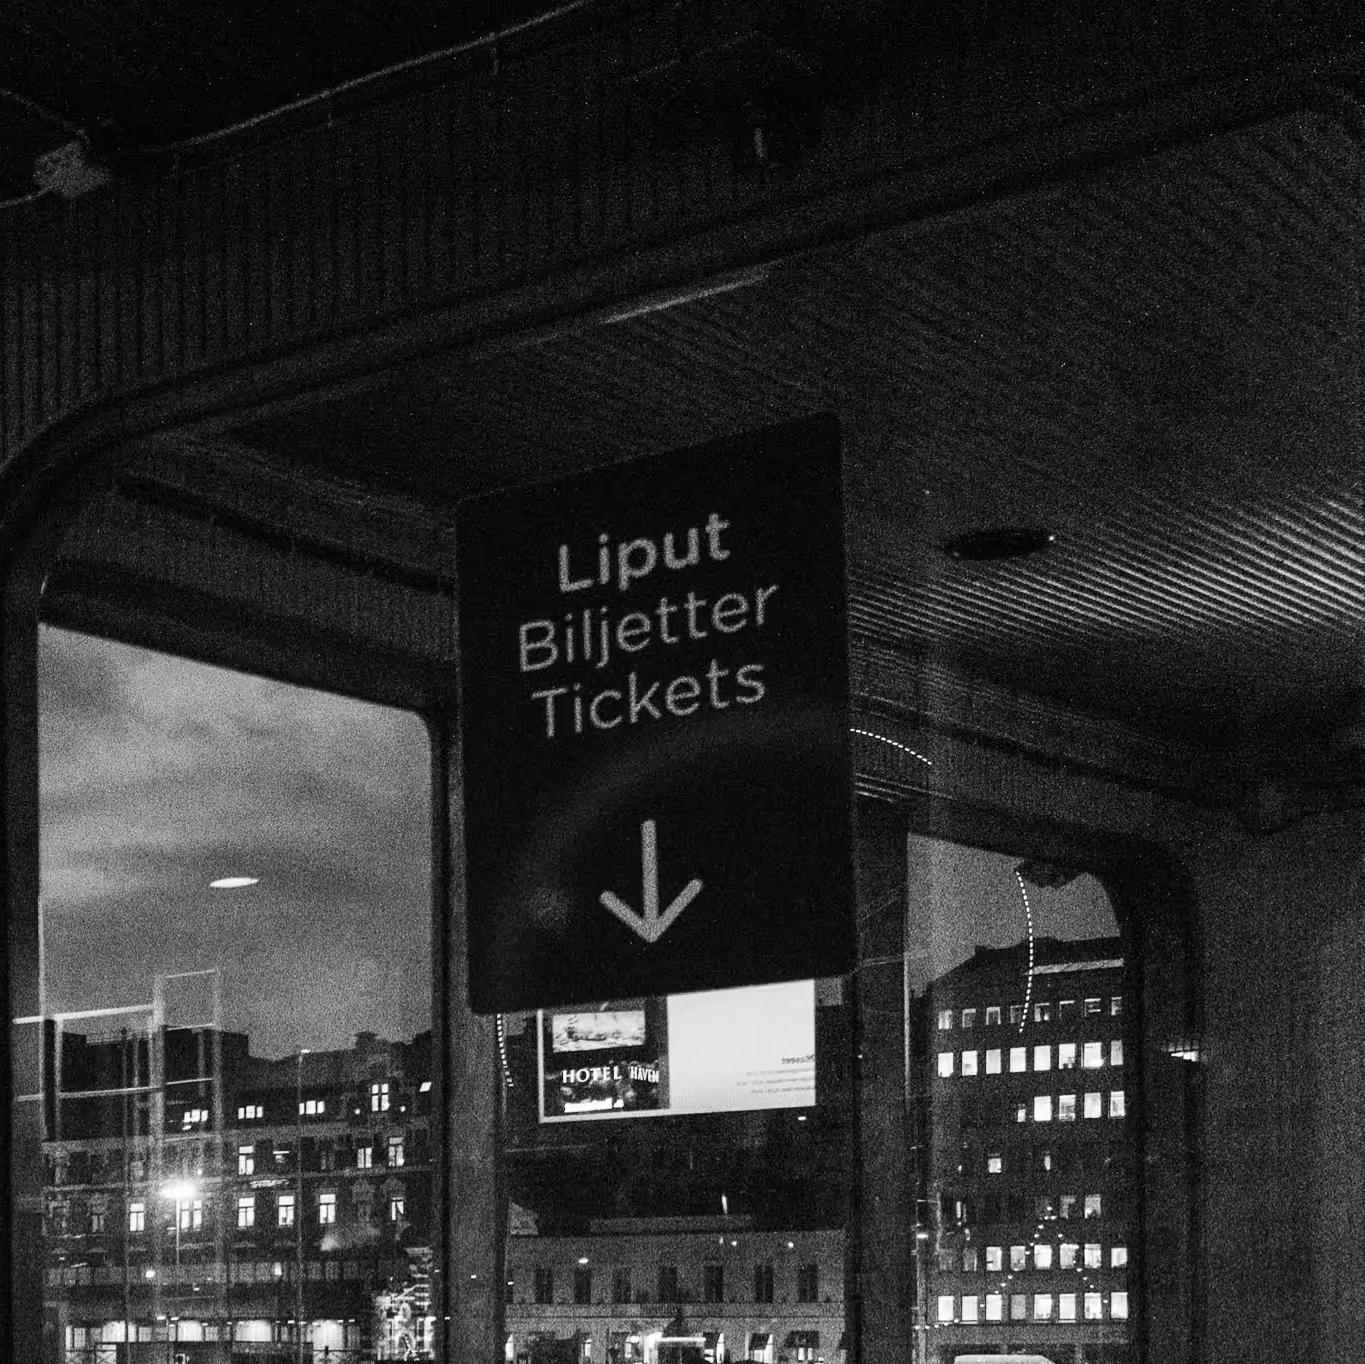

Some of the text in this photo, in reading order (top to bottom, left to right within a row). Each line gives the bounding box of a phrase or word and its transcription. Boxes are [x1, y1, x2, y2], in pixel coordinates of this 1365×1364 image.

[558, 512, 731, 592] Liput
[519, 584, 780, 672] Biljetter
[532, 659, 766, 738] Tickets
[562, 1065, 660, 1084] HOTEL HAVEN
